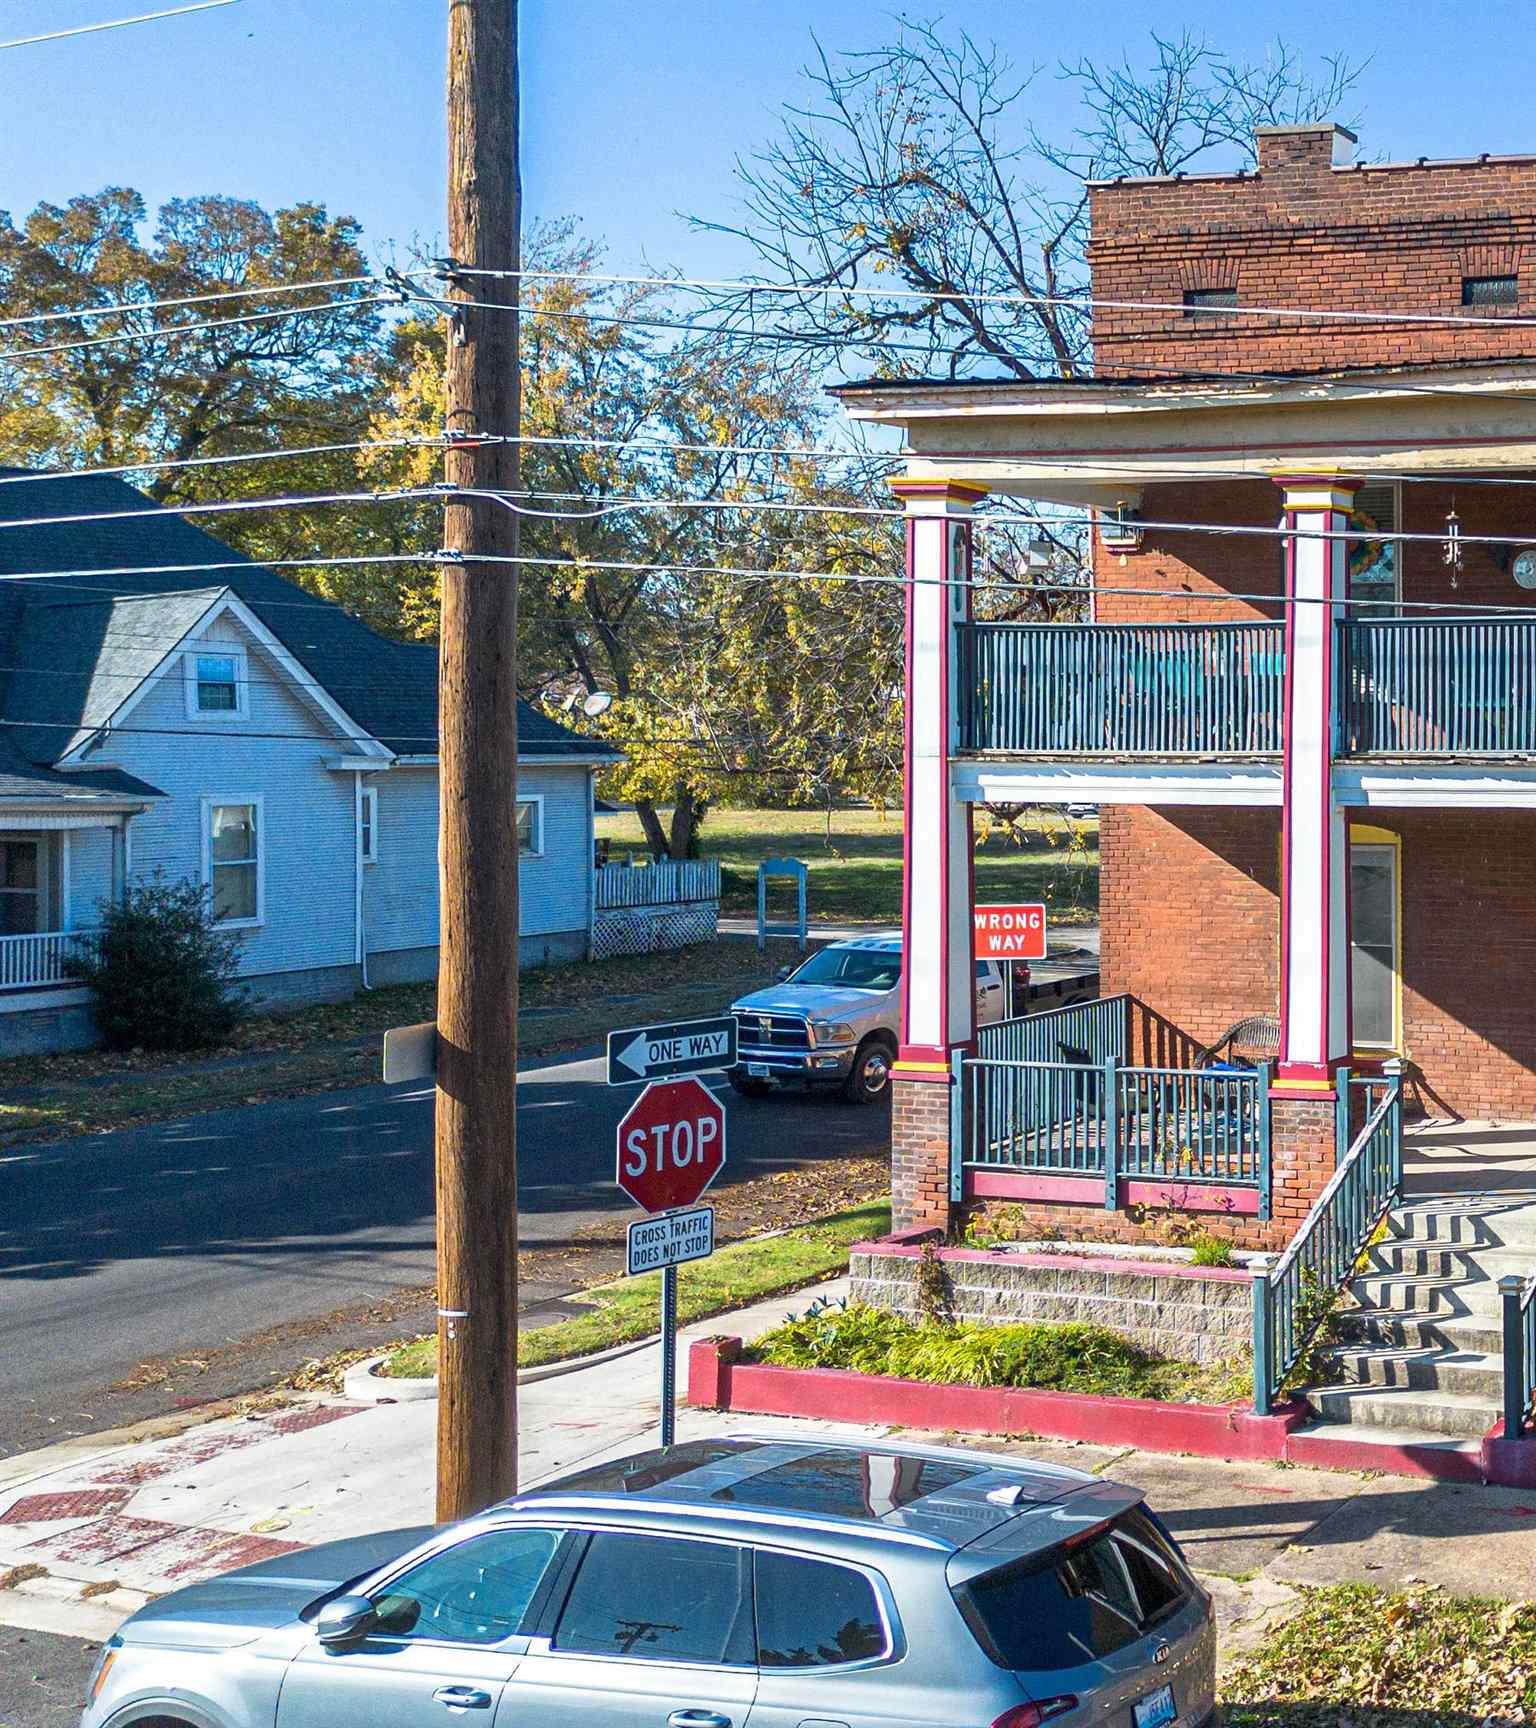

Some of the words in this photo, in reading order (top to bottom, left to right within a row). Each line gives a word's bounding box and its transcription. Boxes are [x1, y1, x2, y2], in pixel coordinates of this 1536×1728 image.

[974, 912, 1040, 929] WRONG
[988, 934, 1025, 951] WAY
[649, 1040, 682, 1062] ONE
[689, 1034, 724, 1056] WAY
[625, 1116, 718, 1177] STOP
[634, 1226, 666, 1246] CROSS
[669, 1216, 709, 1238] TRAFFIC
[633, 1247, 660, 1266] DOES
[662, 1240, 682, 1258] NOT
[686, 1235, 709, 1254] STOP
